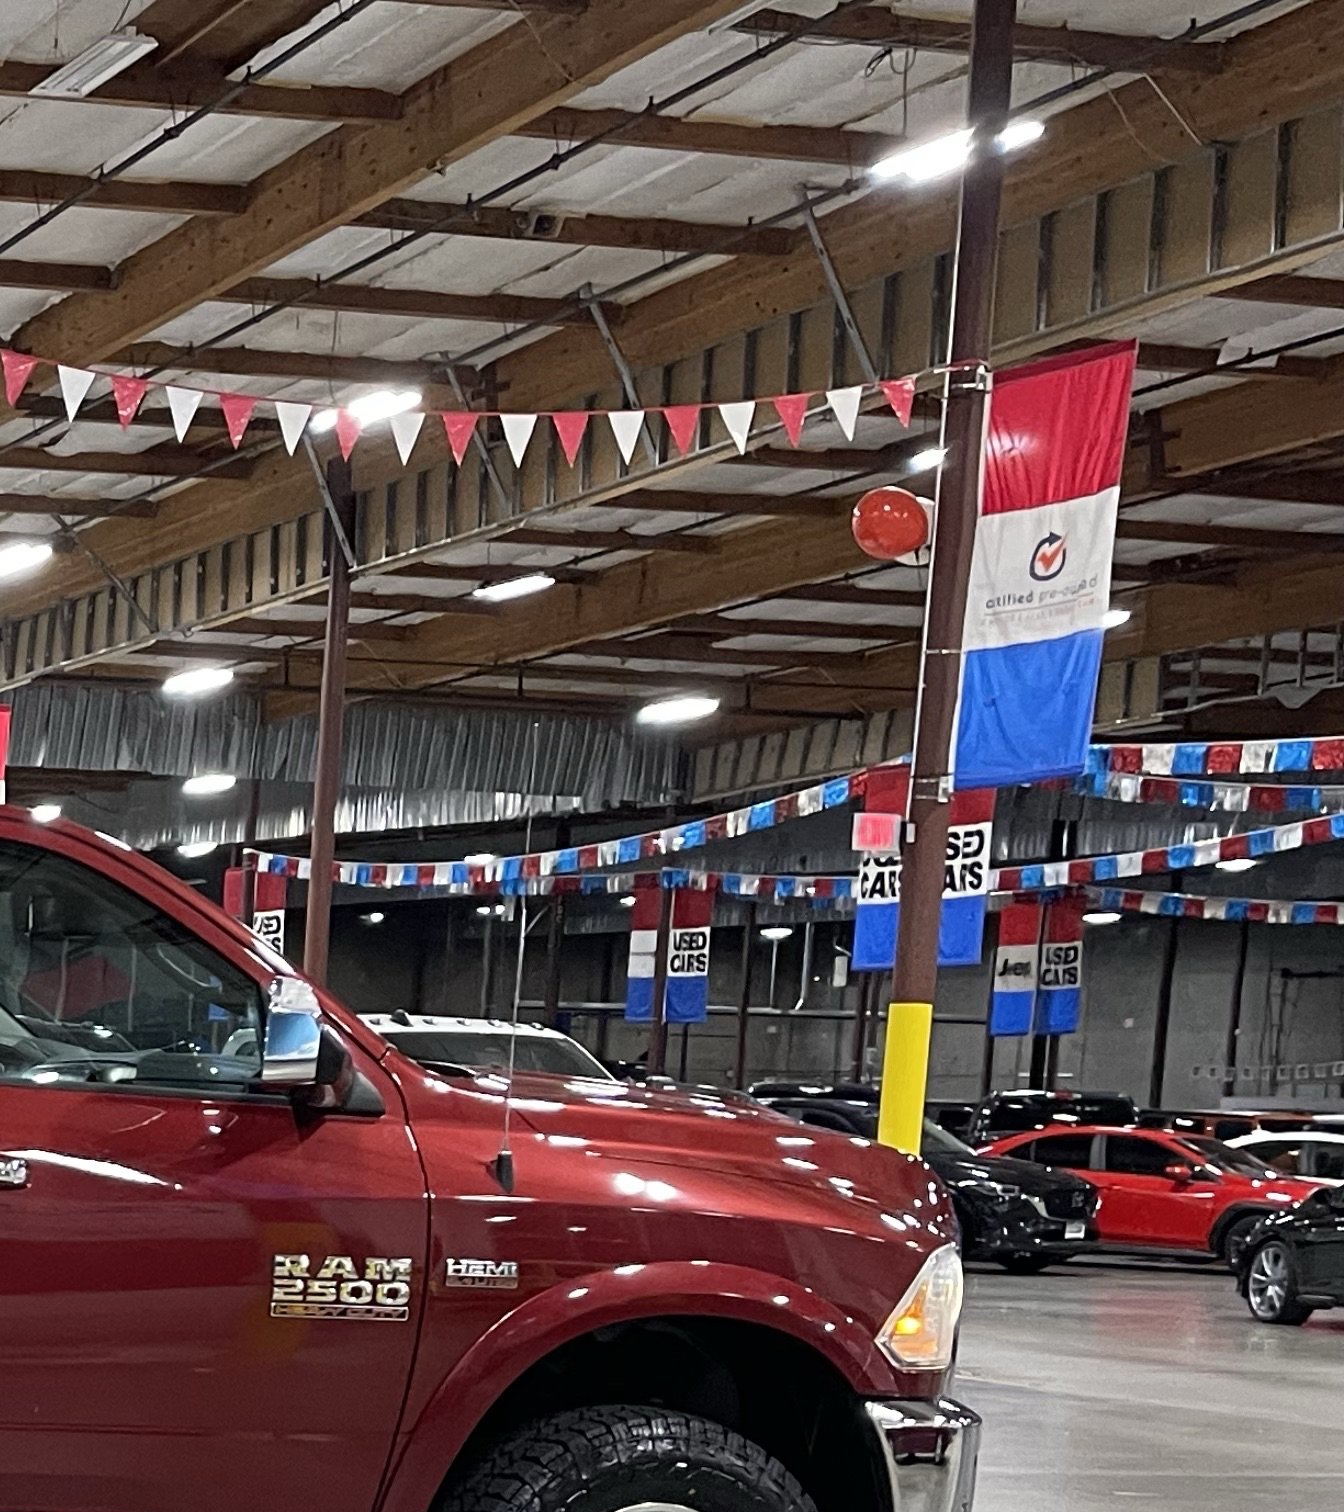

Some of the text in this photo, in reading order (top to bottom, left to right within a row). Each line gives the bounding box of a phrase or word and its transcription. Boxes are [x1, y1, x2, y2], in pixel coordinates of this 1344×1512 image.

[946, 830, 985, 861] SED
[861, 869, 901, 899] CAR
[943, 862, 983, 892] ARS
[673, 931, 707, 952] USED
[273, 1253, 413, 1281] RAM
[446, 1258, 518, 1278] HEMI
[272, 1278, 411, 1306] 2500
[273, 1303, 403, 1319] HEAVY DUTY
